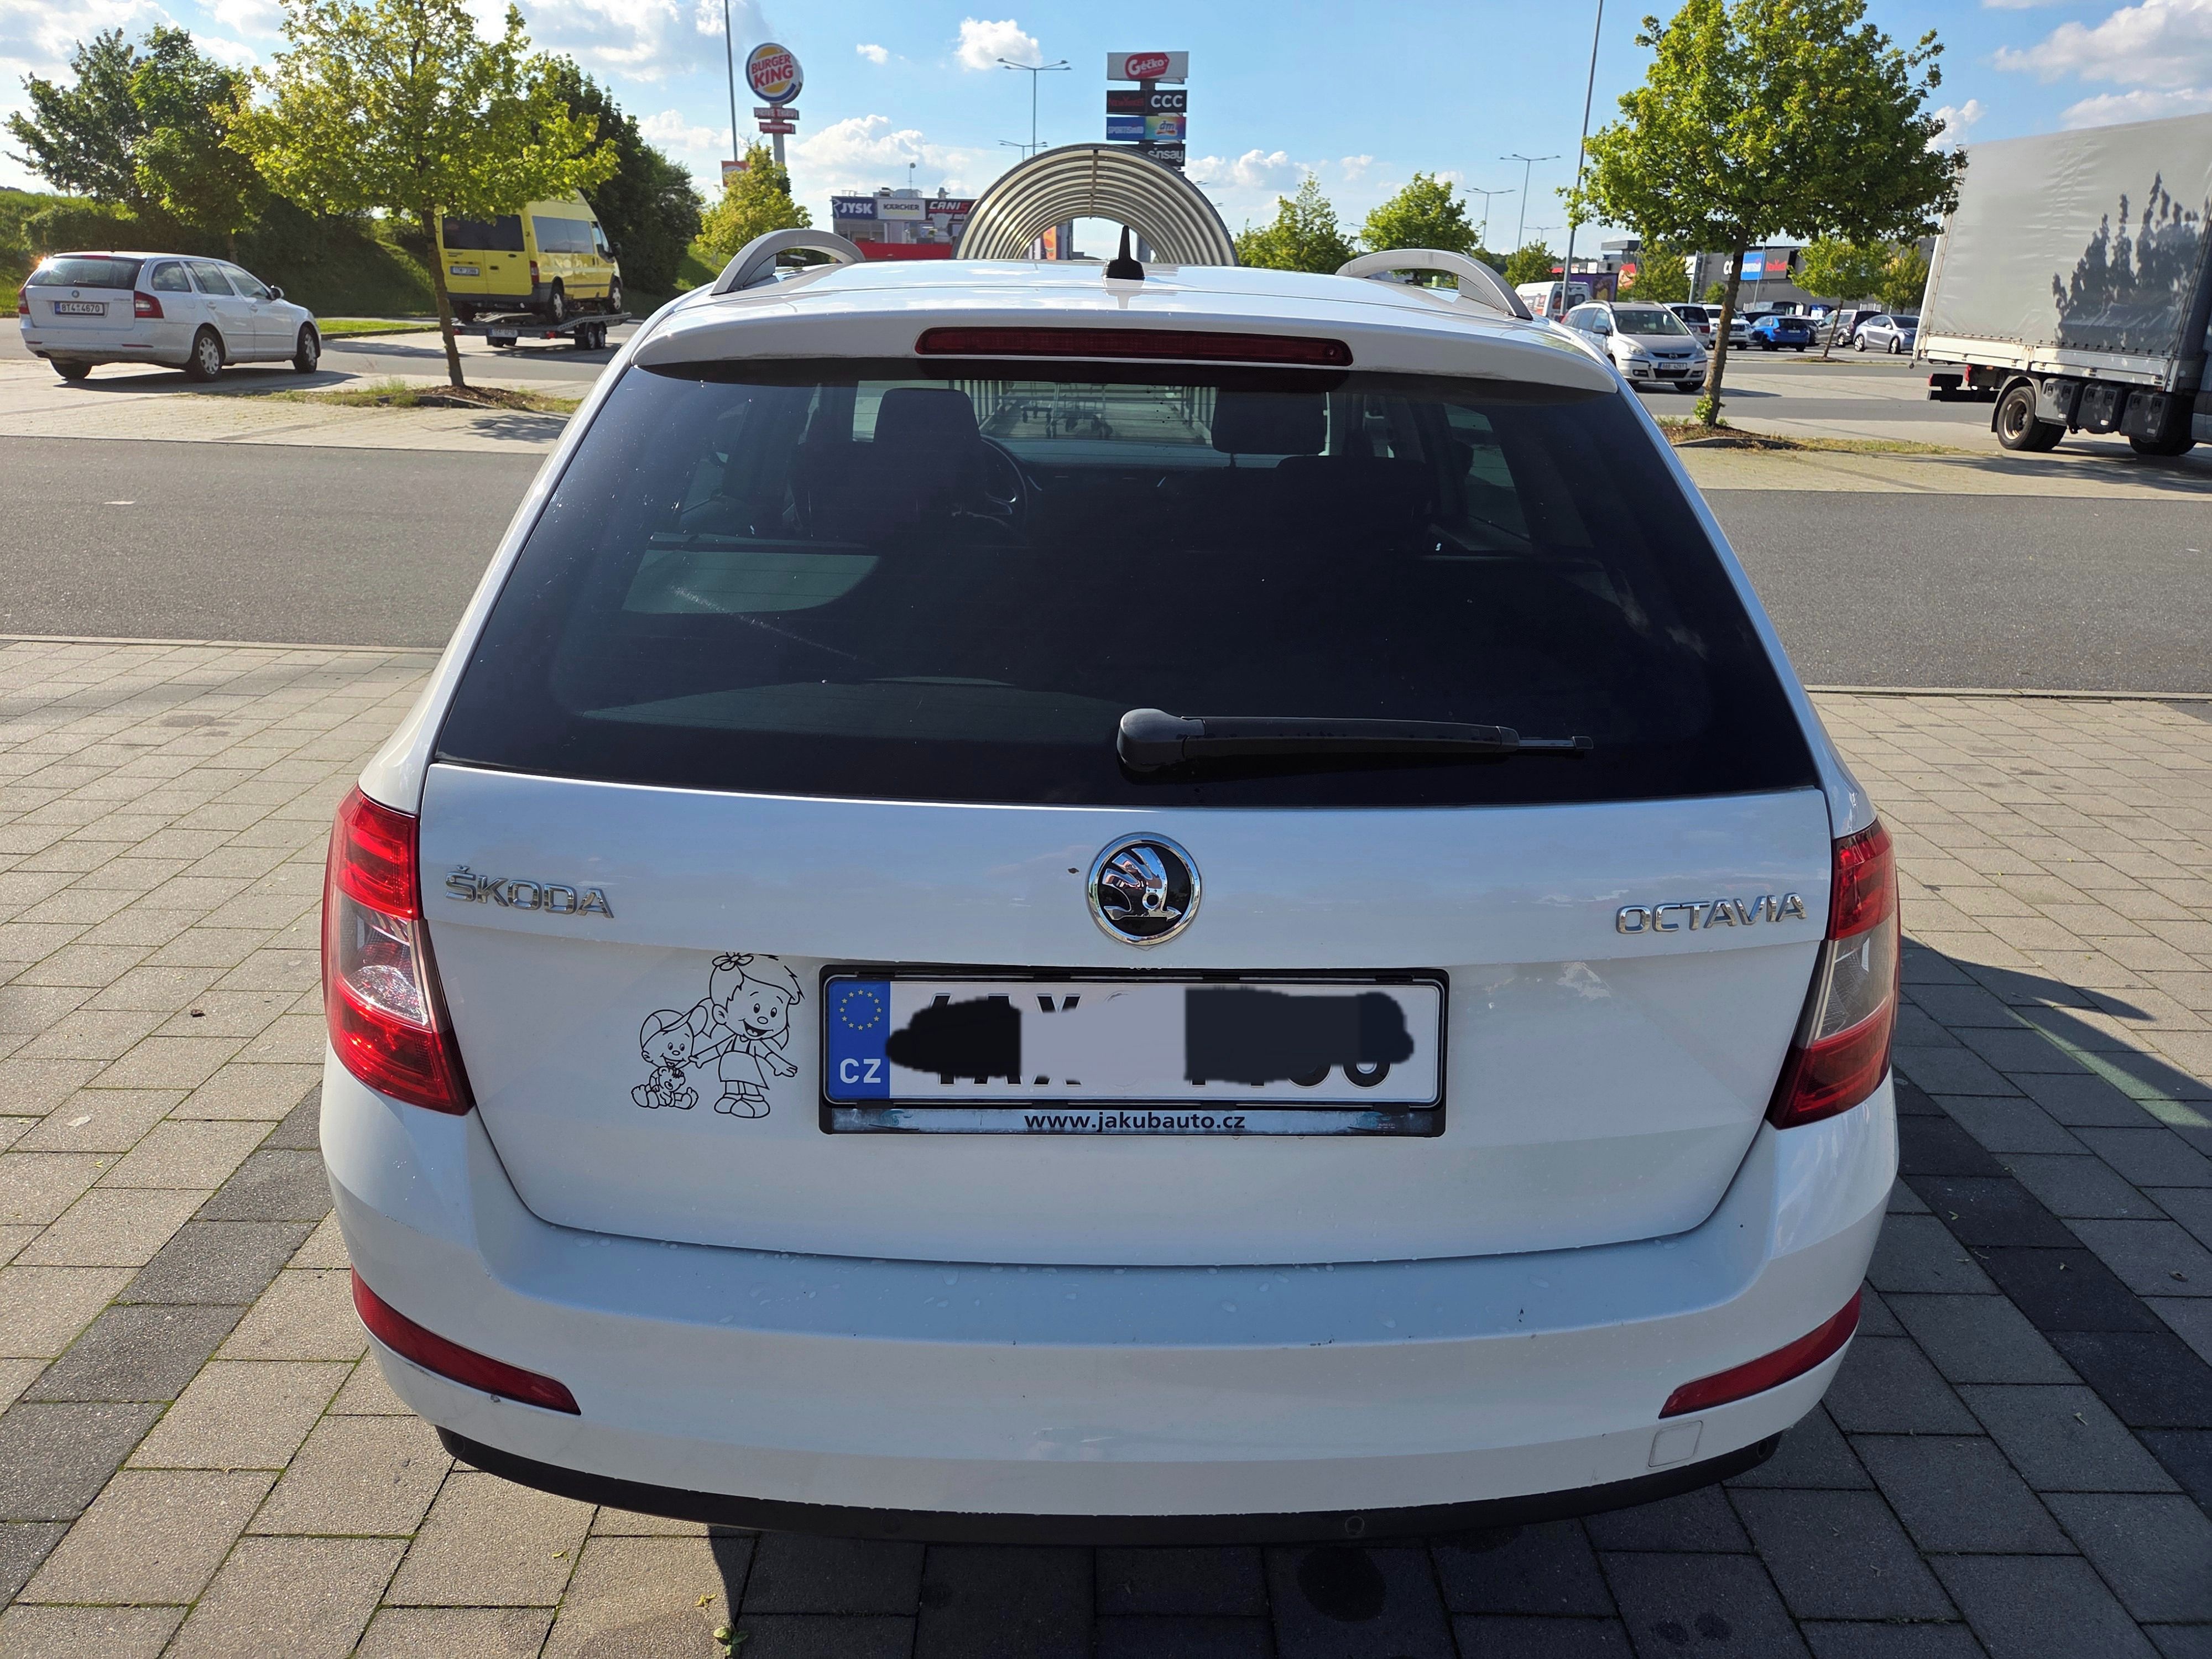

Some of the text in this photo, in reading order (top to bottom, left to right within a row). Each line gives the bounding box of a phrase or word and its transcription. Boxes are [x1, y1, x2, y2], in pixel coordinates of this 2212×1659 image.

[752, 55, 791, 74] BURGER
[754, 65, 792, 88] KING
[1151, 95, 1183, 107] CCC
[1159, 120, 1176, 131] dm
[840, 202, 873, 214] JYSK
[445, 864, 614, 919] ŠKODA
[1616, 892, 1807, 934] OCTAVIA
[839, 1058, 881, 1084] CZ
[1024, 1112, 1245, 1133] www.jakubauto.cz
